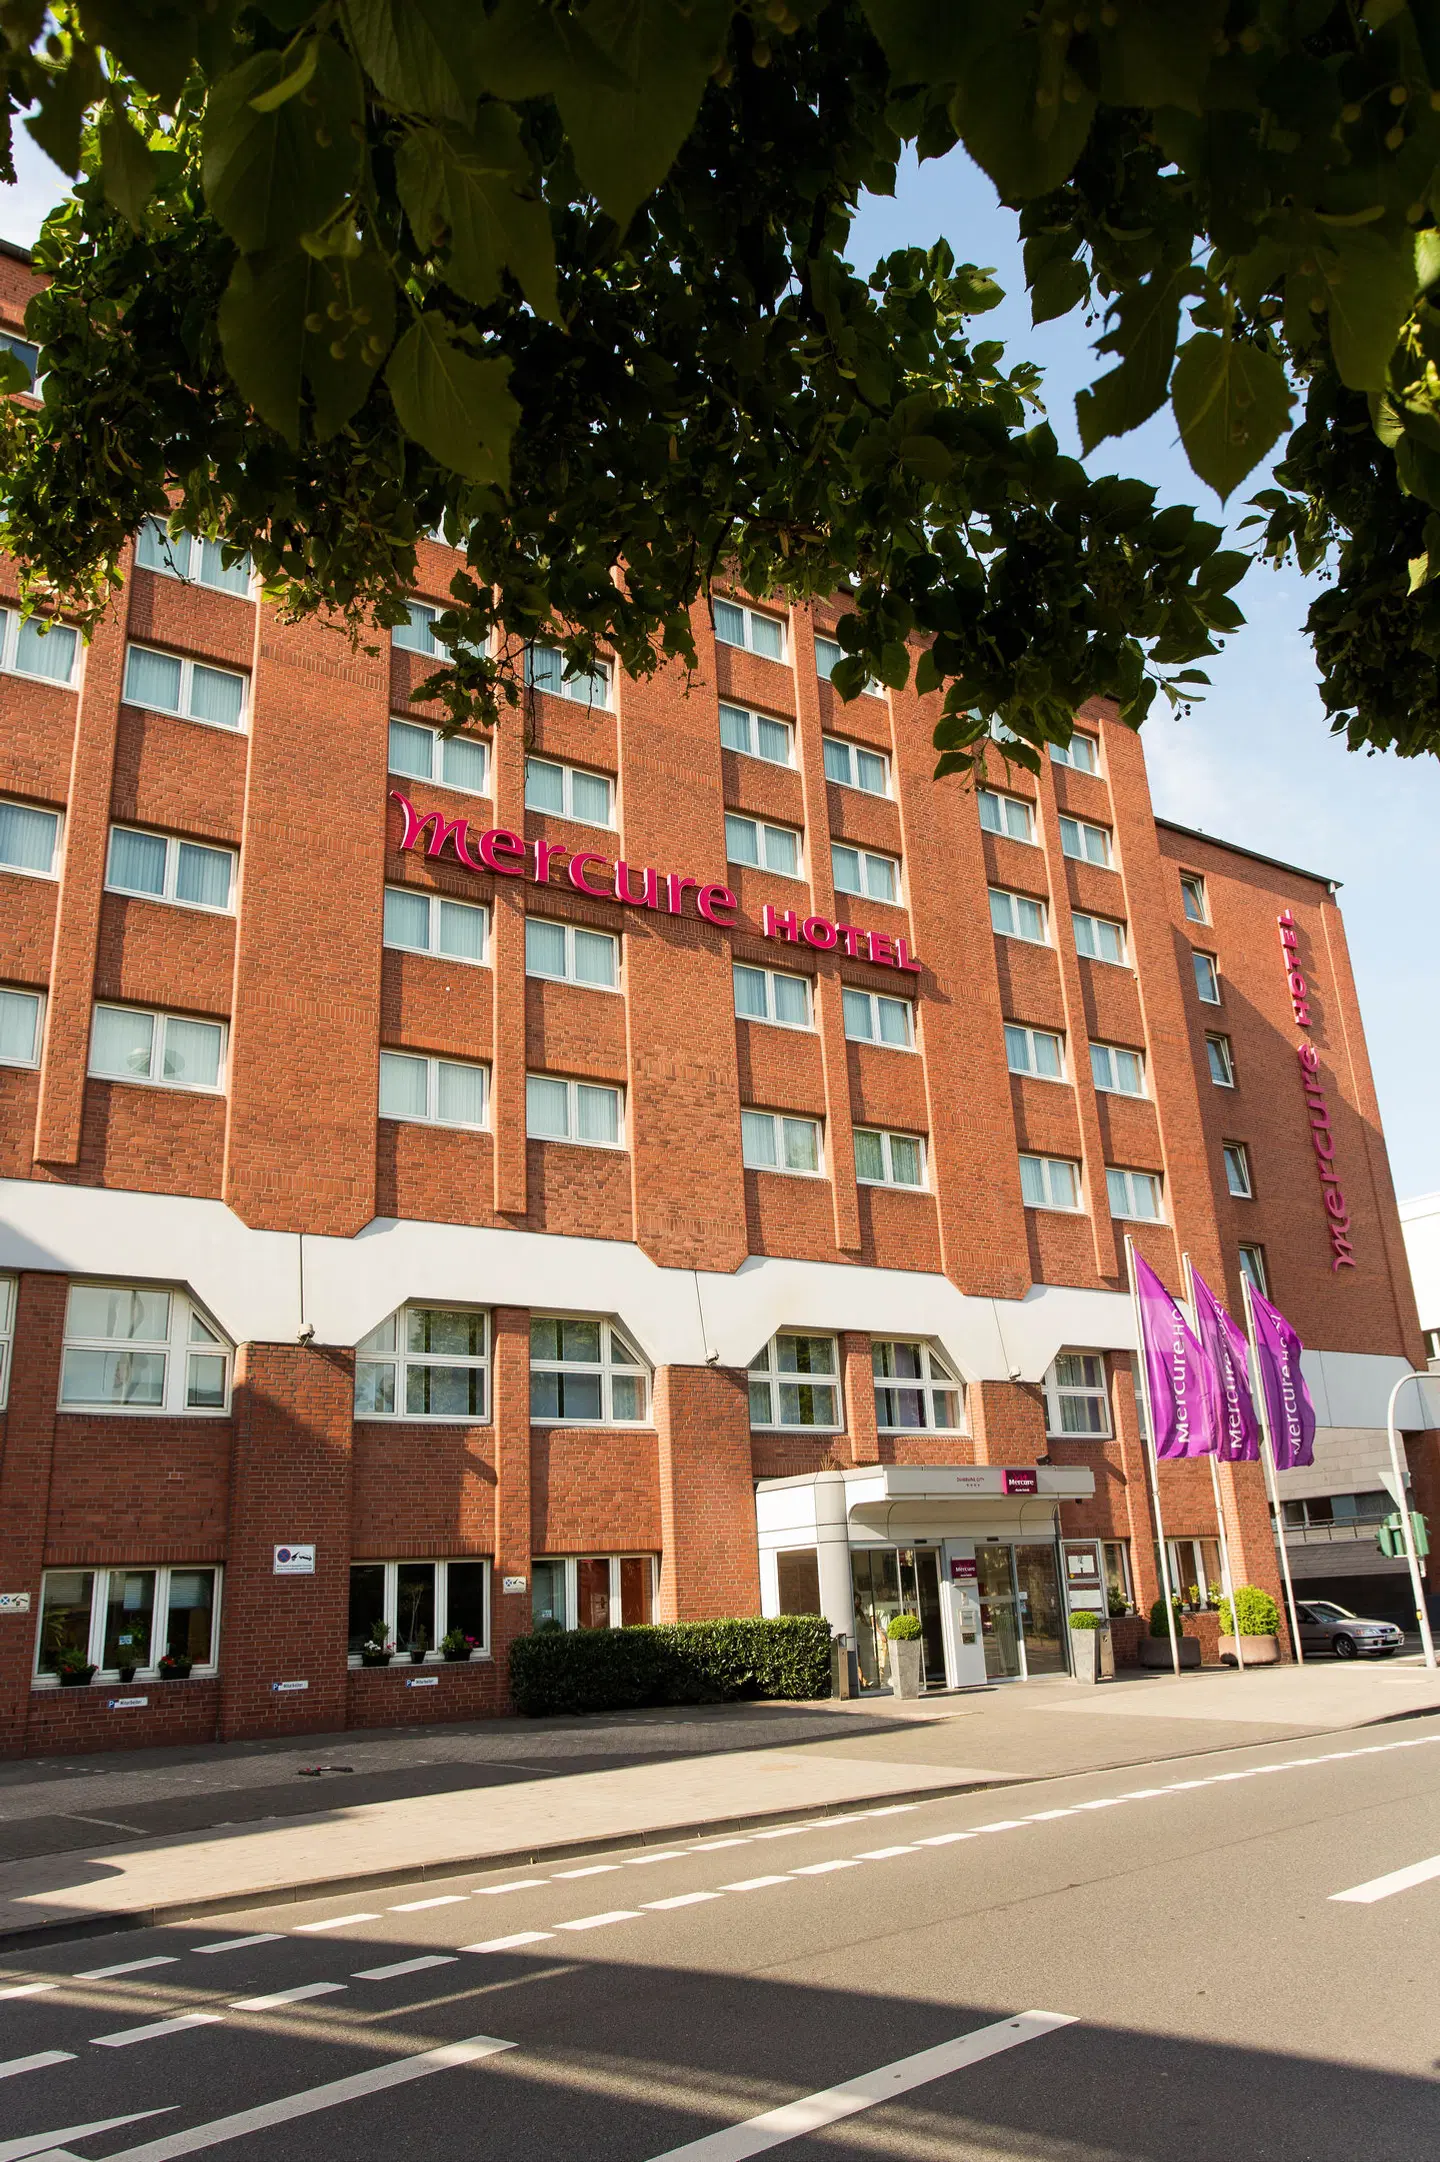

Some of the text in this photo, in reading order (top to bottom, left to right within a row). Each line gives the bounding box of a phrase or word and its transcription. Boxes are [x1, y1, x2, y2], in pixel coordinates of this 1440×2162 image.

[762, 903, 922, 973] HOTEL
[1277, 908, 1312, 1027] HOTEL
[1172, 1341, 1191, 1444] Mercure
